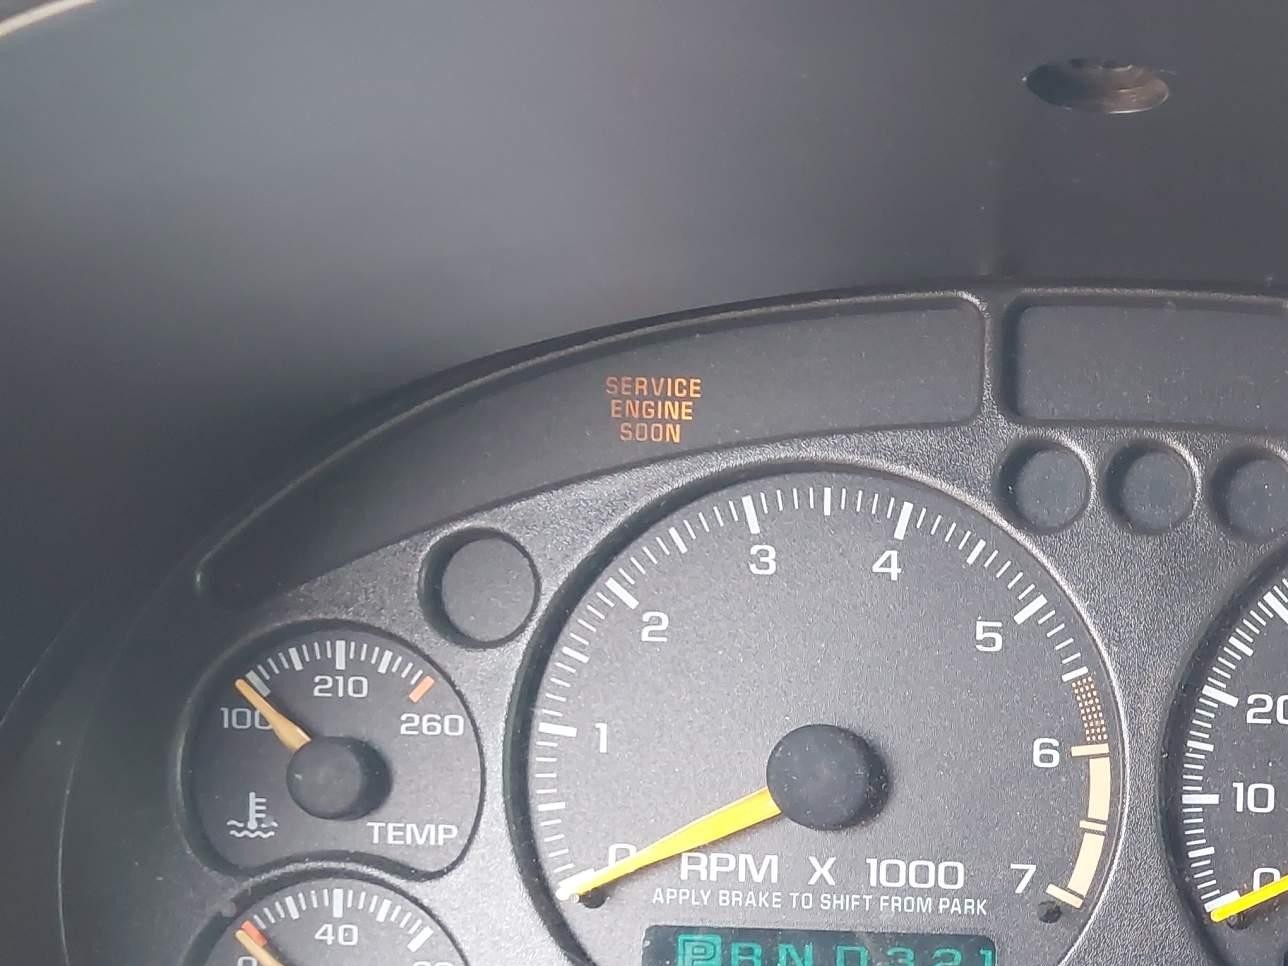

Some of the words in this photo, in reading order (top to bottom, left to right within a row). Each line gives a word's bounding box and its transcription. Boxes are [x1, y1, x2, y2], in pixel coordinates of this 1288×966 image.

[606, 376, 702, 398] SERVICE
[611, 400, 693, 420] ENGINE
[620, 423, 681, 443] SOON
[749, 544, 776, 575] 3
[871, 550, 901, 581] 4
[641, 611, 669, 642] 2
[975, 620, 1003, 652] 5
[313, 676, 368, 698] 210
[400, 714, 464, 736] 260
[595, 723, 609, 753] 1
[1033, 737, 1060, 768] 6
[1233, 782, 1275, 813] 10
[367, 822, 458, 846] TEMP
[680, 852, 778, 883] RPM
[808, 856, 836, 886] X
[866, 858, 965, 890] 1000
[1010, 864, 1037, 894] 7
[653, 887, 711, 906] APPLY
[719, 889, 782, 908] BRAKE
[790, 892, 812, 909] TO
[820, 893, 872, 912] SHIFT
[880, 895, 932, 914] FROM
[939, 897, 987, 915] PARK
[315, 924, 358, 945] 40
